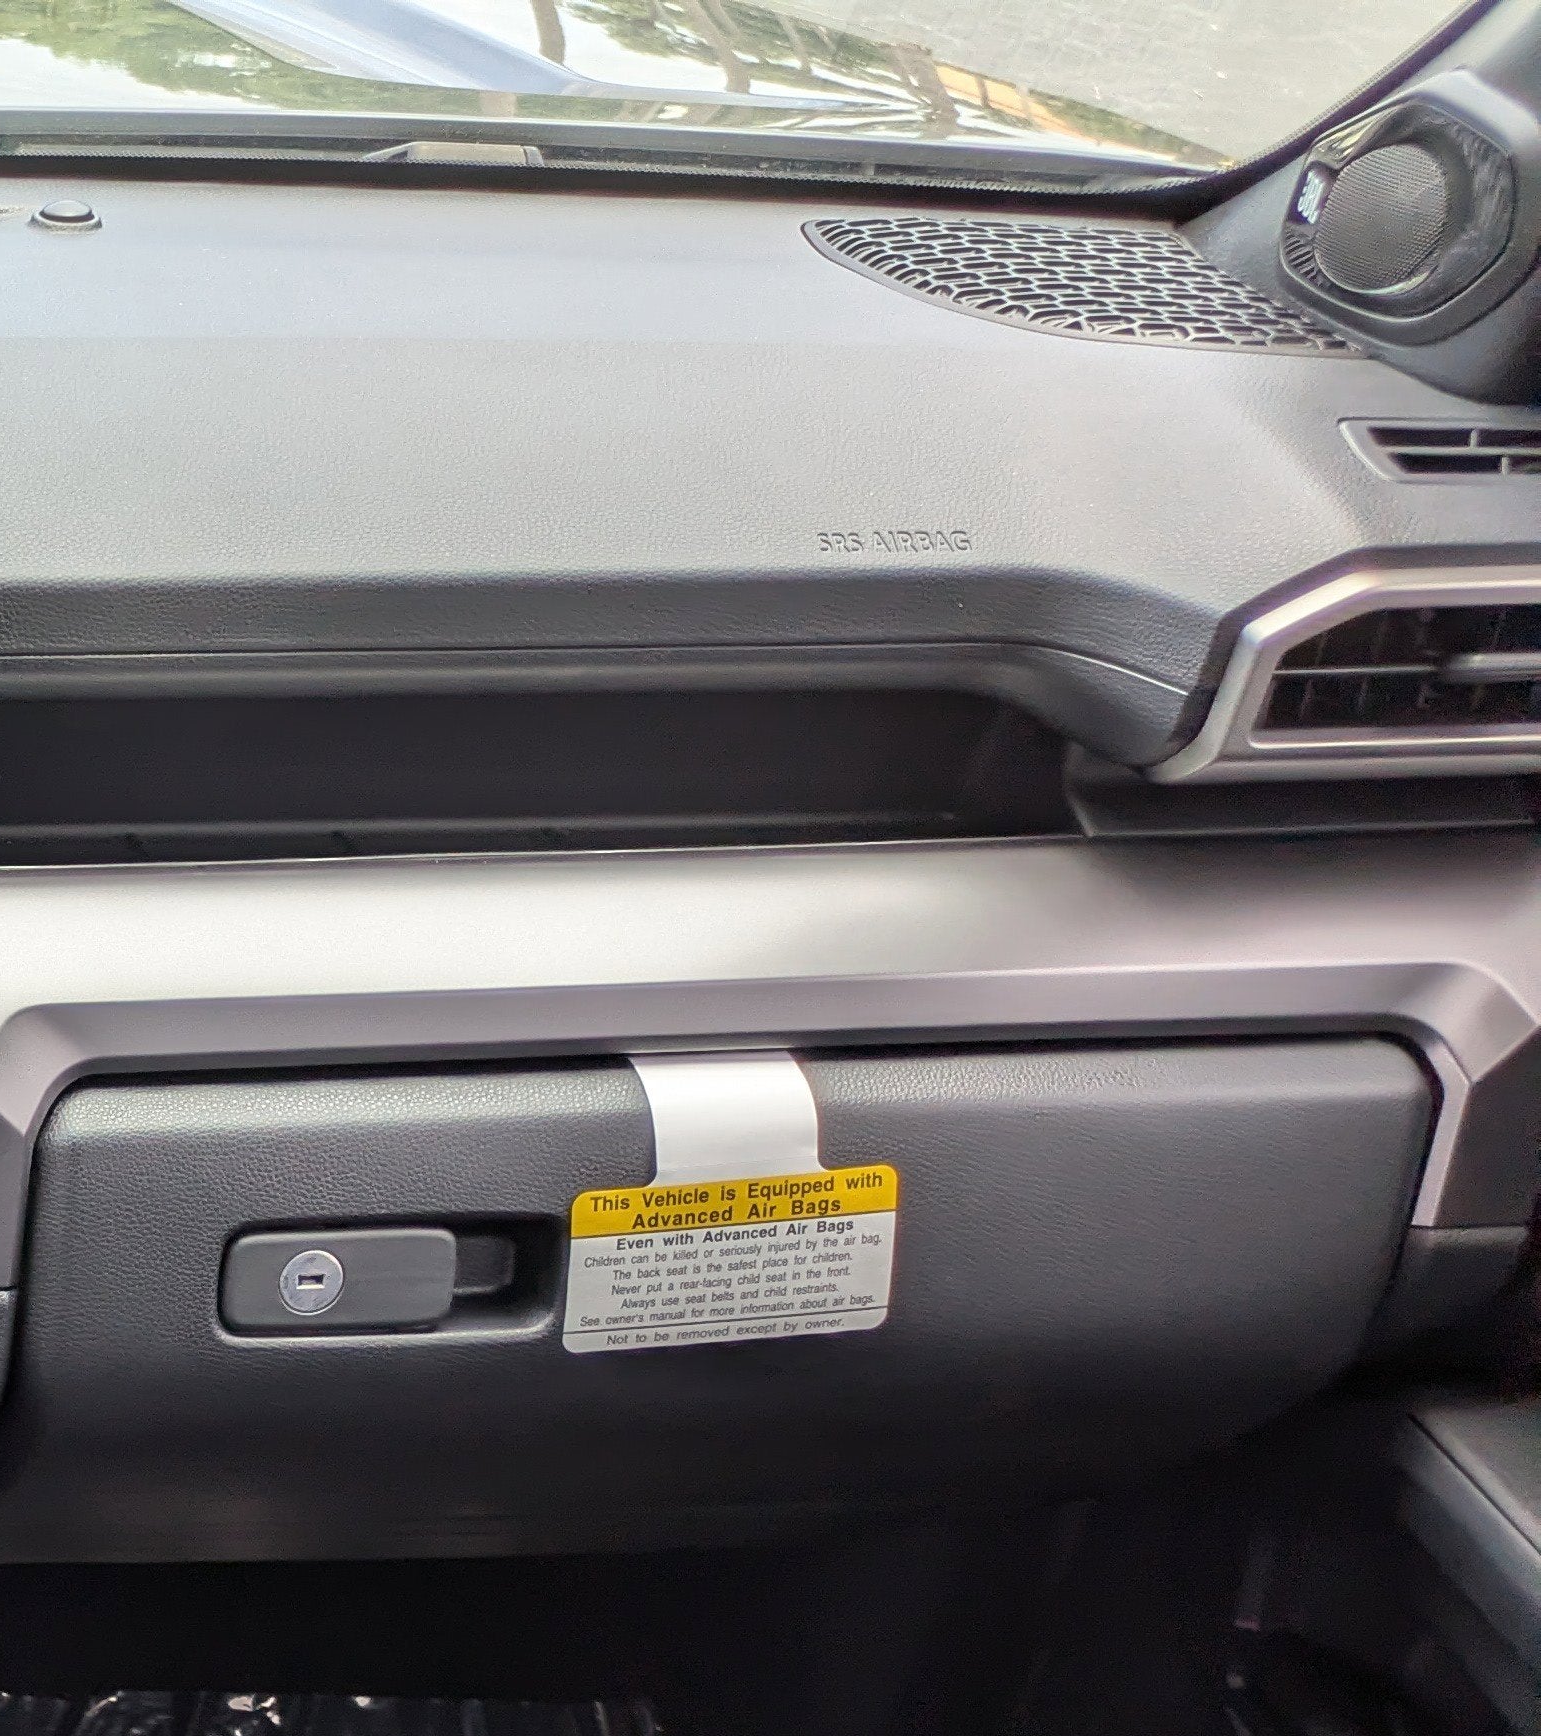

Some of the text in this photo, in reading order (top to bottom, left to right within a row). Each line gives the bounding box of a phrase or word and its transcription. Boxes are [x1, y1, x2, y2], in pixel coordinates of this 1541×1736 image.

[817, 530, 973, 553] SRS AIRBAG
[590, 1172, 883, 1212] This Vehicle is Equipped with
[632, 1199, 841, 1230] Advanced Air Bags
[584, 1233, 883, 1268] Children can be killed or seriously injured by the air bag.
[616, 1220, 854, 1251] Even with Advanced Air Bags
[611, 1266, 851, 1296] Never put a rear-facing child seat in the front.
[613, 1252, 853, 1281] The back seat is the safest place for children.
[580, 1296, 845, 1327] See owner's manual for more information about air
[620, 1282, 839, 1311] Always use seat belts and child restraints.
[607, 1318, 845, 1347] Not to be removed except by owner.
